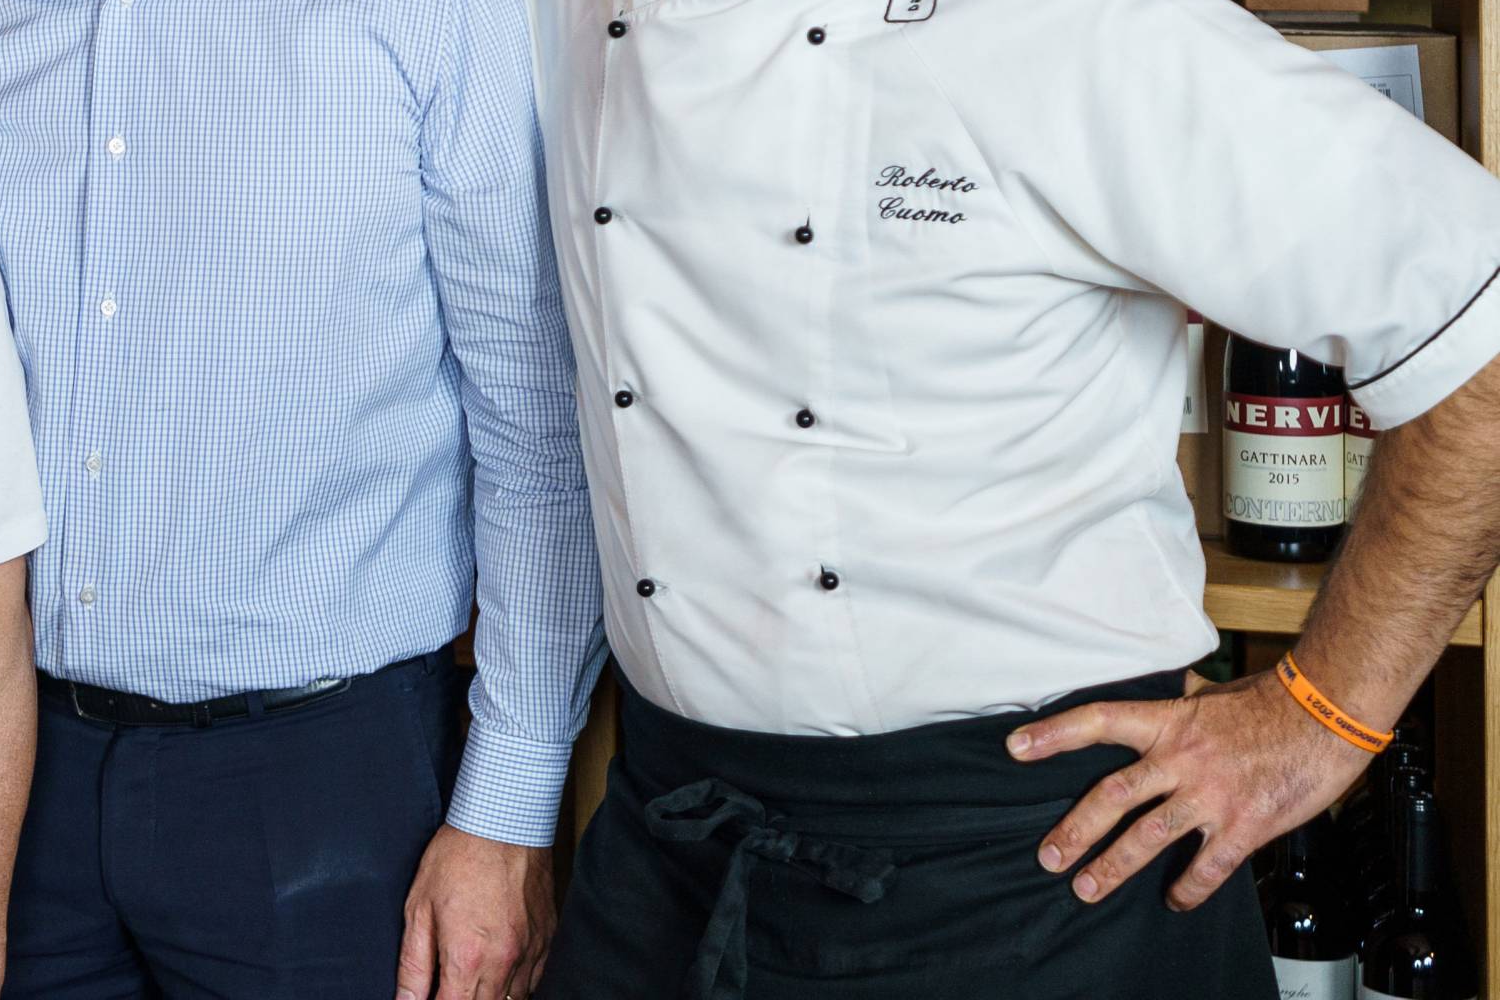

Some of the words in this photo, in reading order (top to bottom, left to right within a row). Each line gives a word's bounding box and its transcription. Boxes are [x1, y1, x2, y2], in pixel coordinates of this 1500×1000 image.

[875, 165, 980, 193] Roberto
[878, 196, 969, 225] Cuomo
[1226, 400, 1341, 429] NERVI
[1239, 450, 1328, 466] GATTINARA
[1268, 471, 1300, 485] 2015
[1305, 694, 1335, 719] 2021
